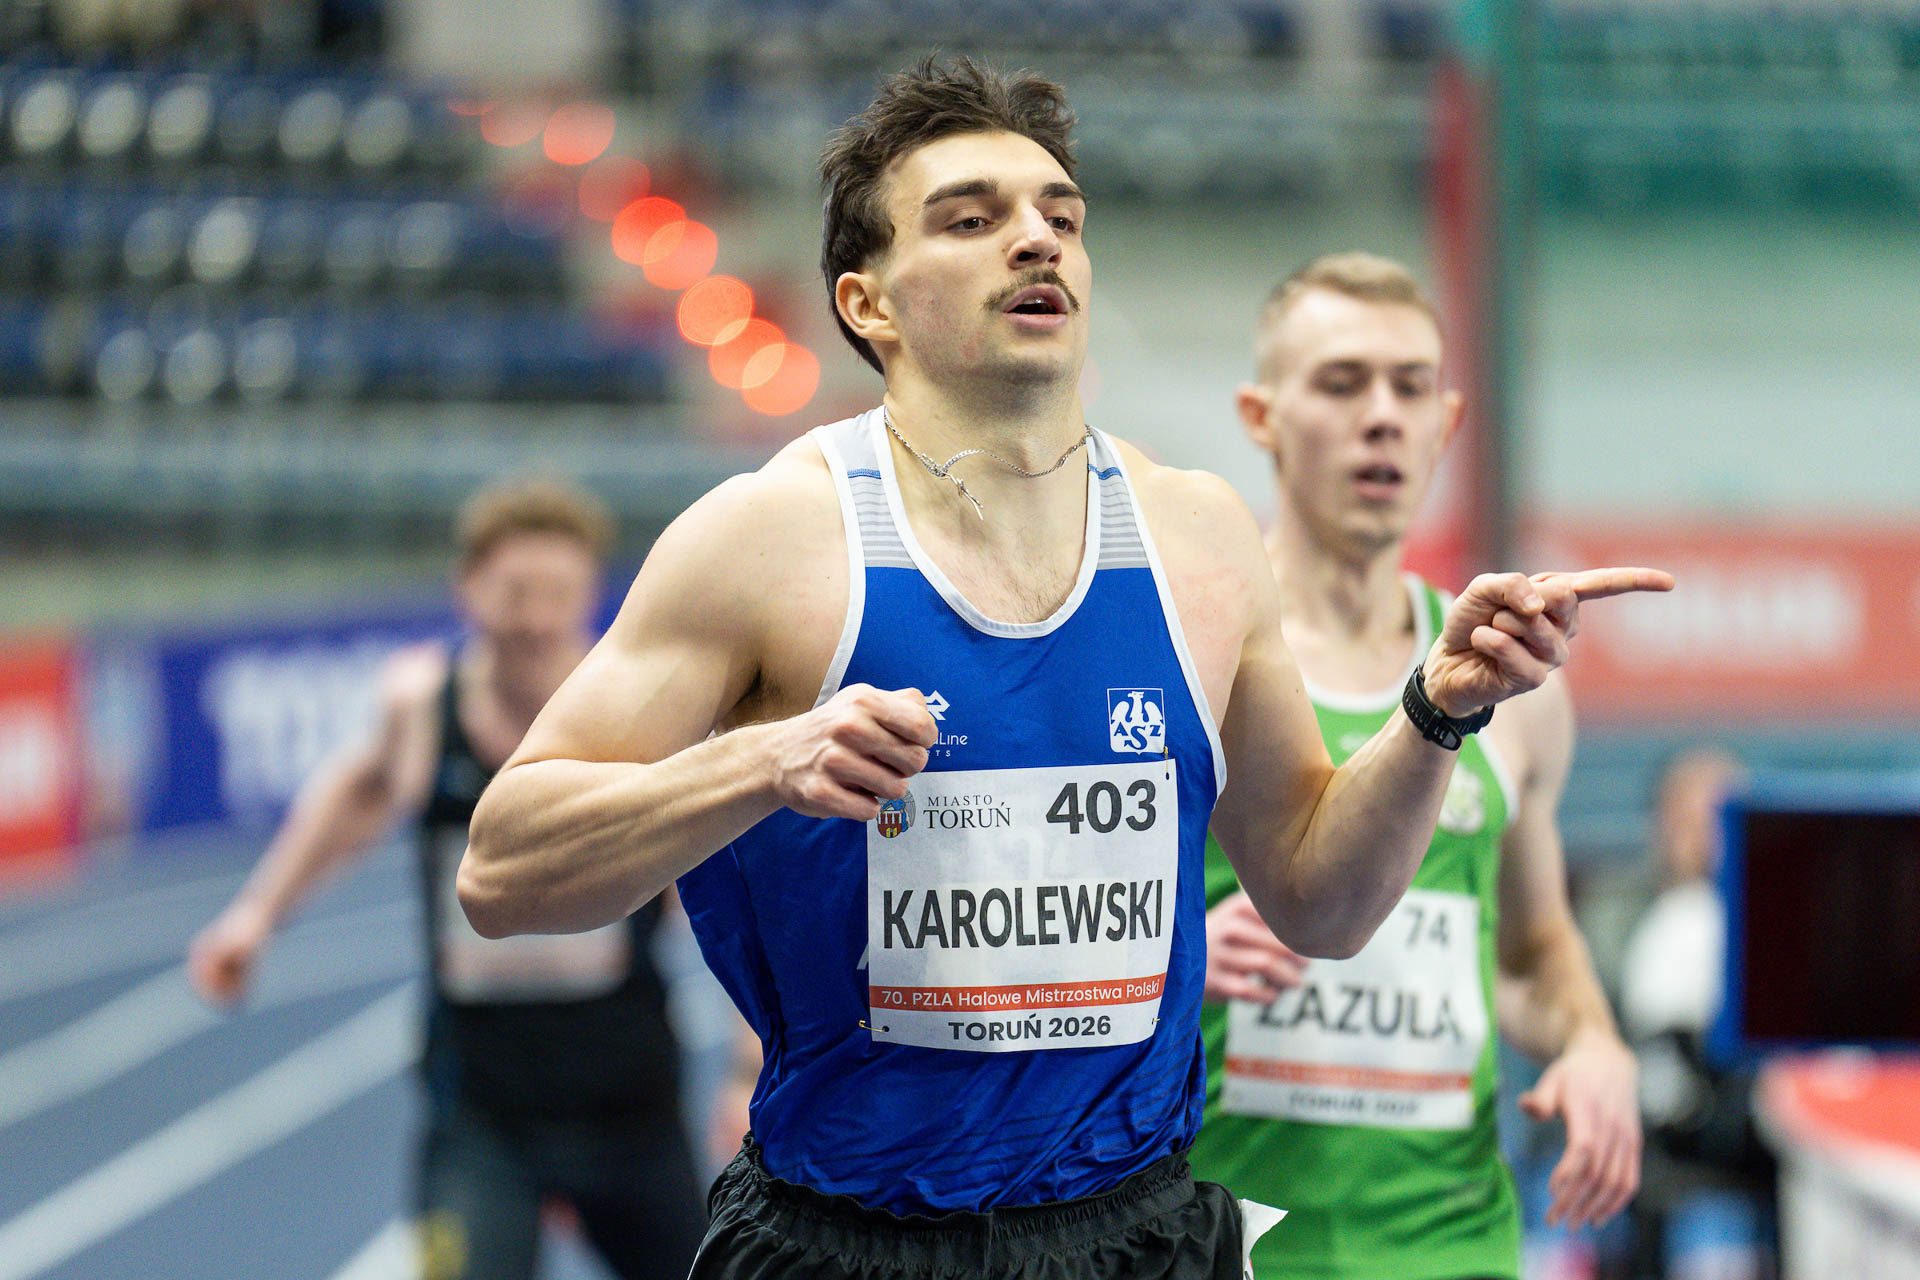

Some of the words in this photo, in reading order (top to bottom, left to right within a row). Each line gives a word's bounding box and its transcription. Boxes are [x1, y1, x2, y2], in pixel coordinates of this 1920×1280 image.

[934, 732, 968, 745] Line
[1113, 722, 1162, 751] ASZ
[923, 801, 1011, 829] TORUŃ
[928, 794, 992, 807] MIASTO
[1045, 779, 1157, 835] 403
[883, 879, 1163, 949] KAROLEWSKI
[1405, 906, 1450, 947] 74
[882, 990, 907, 1006] 70.
[912, 991, 953, 1007] PZLA
[959, 990, 1021, 1007] Halowe
[1026, 984, 1122, 1003] Mistrzostwa
[1126, 981, 1160, 997] Polski
[948, 1013, 1042, 1042] TORUŃ
[1049, 1015, 1111, 1038] 2026
